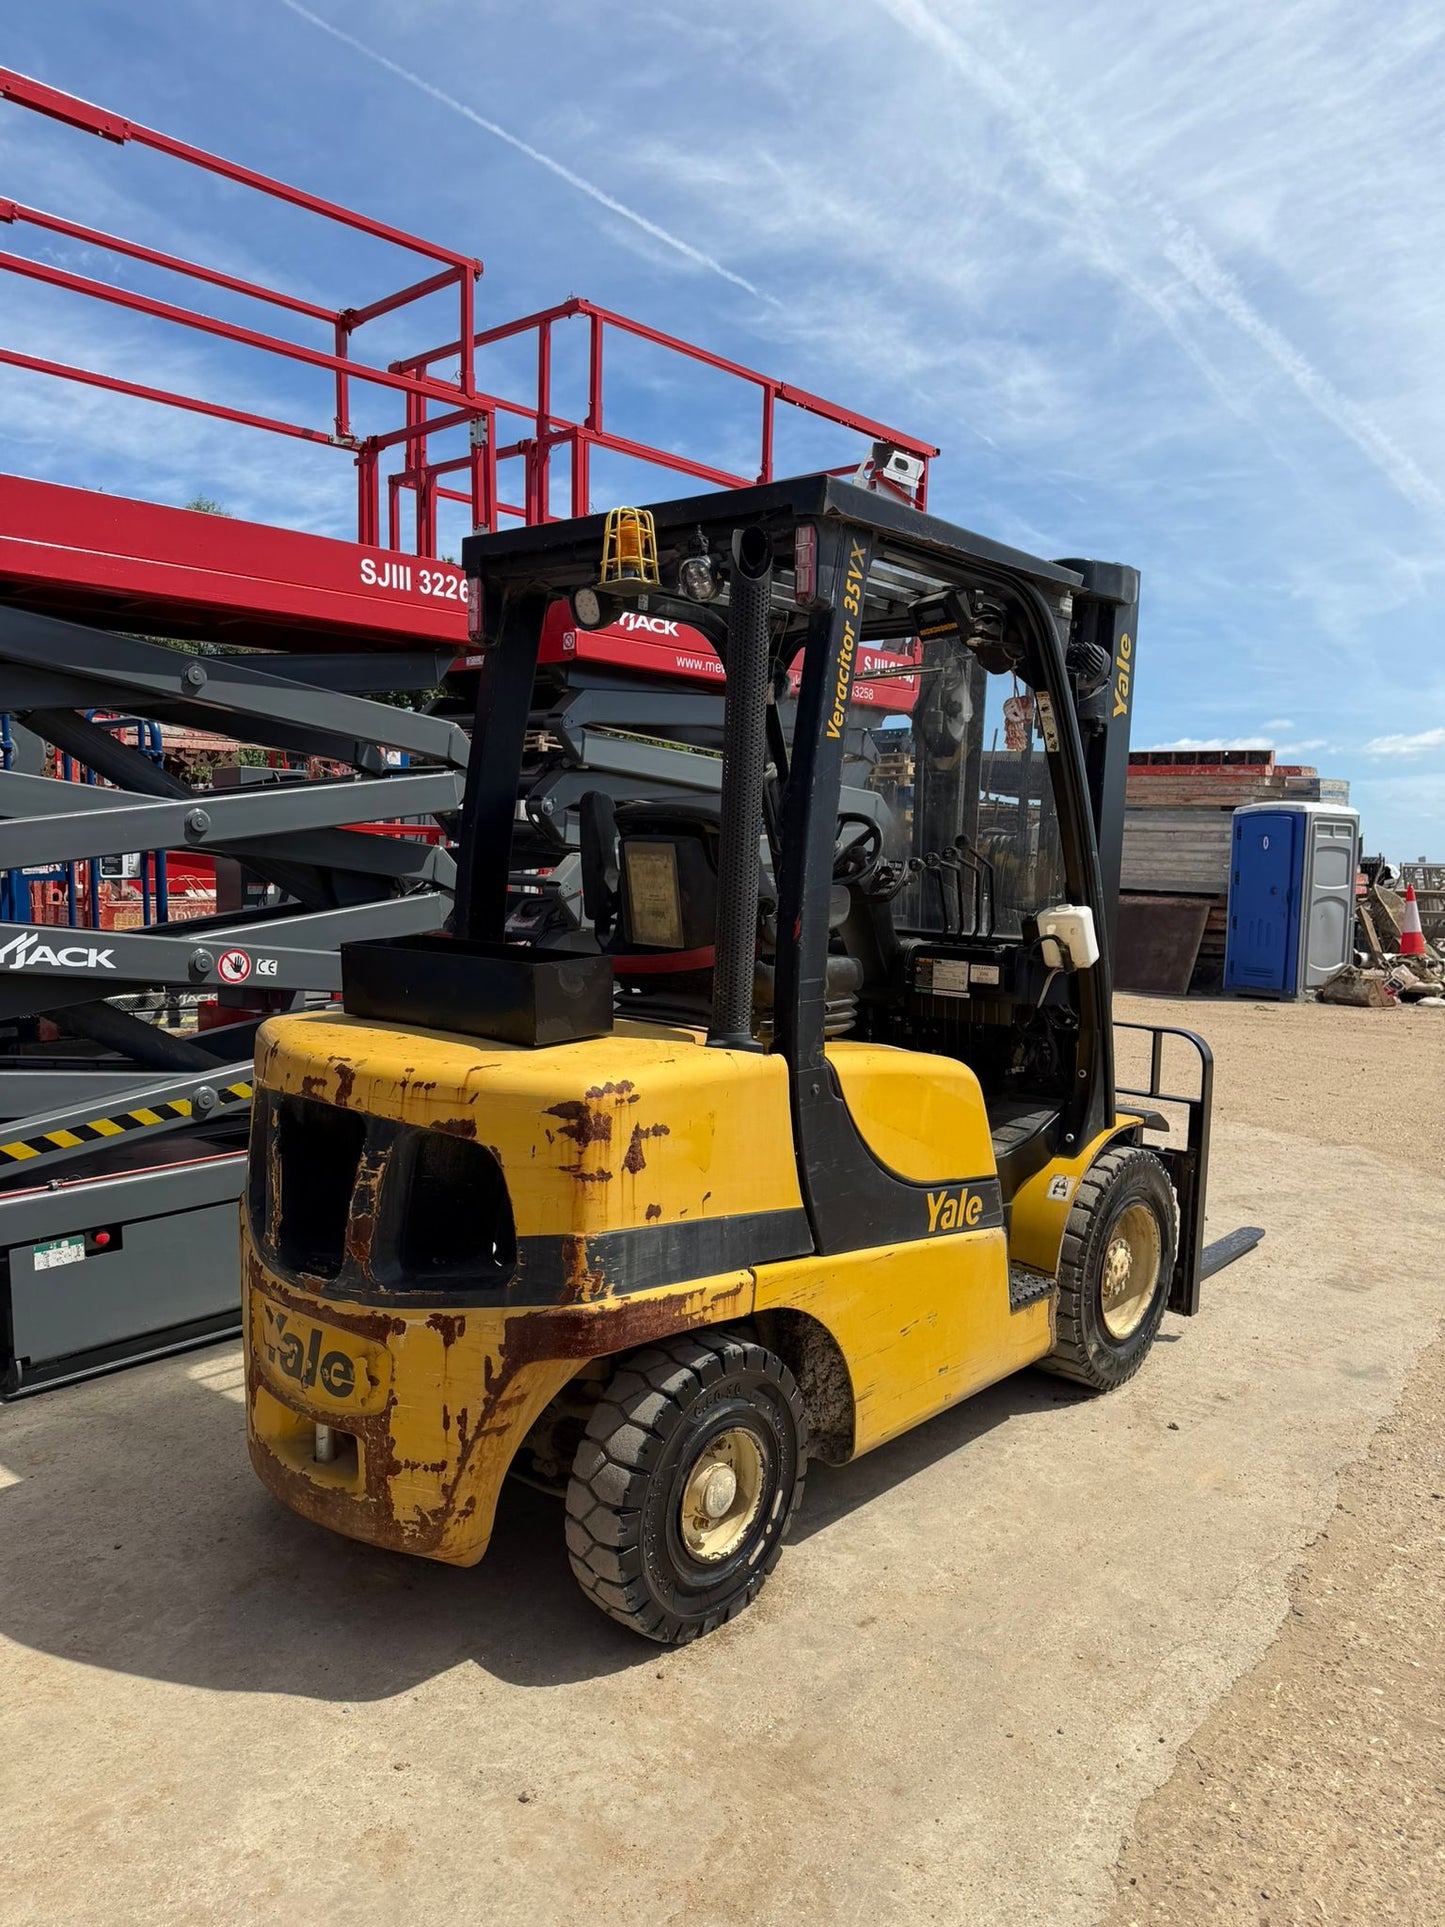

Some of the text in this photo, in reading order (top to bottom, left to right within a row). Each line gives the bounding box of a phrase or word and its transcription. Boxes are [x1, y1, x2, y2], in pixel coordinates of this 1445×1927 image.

[360, 558, 469, 603] SJIII 3226
[825, 537, 868, 740] Veracitor 35VX
[851, 685, 875, 700] 3258
[1112, 632, 1132, 718] Yale
[257, 960, 277, 974] CE
[926, 1187, 983, 1233] Yale
